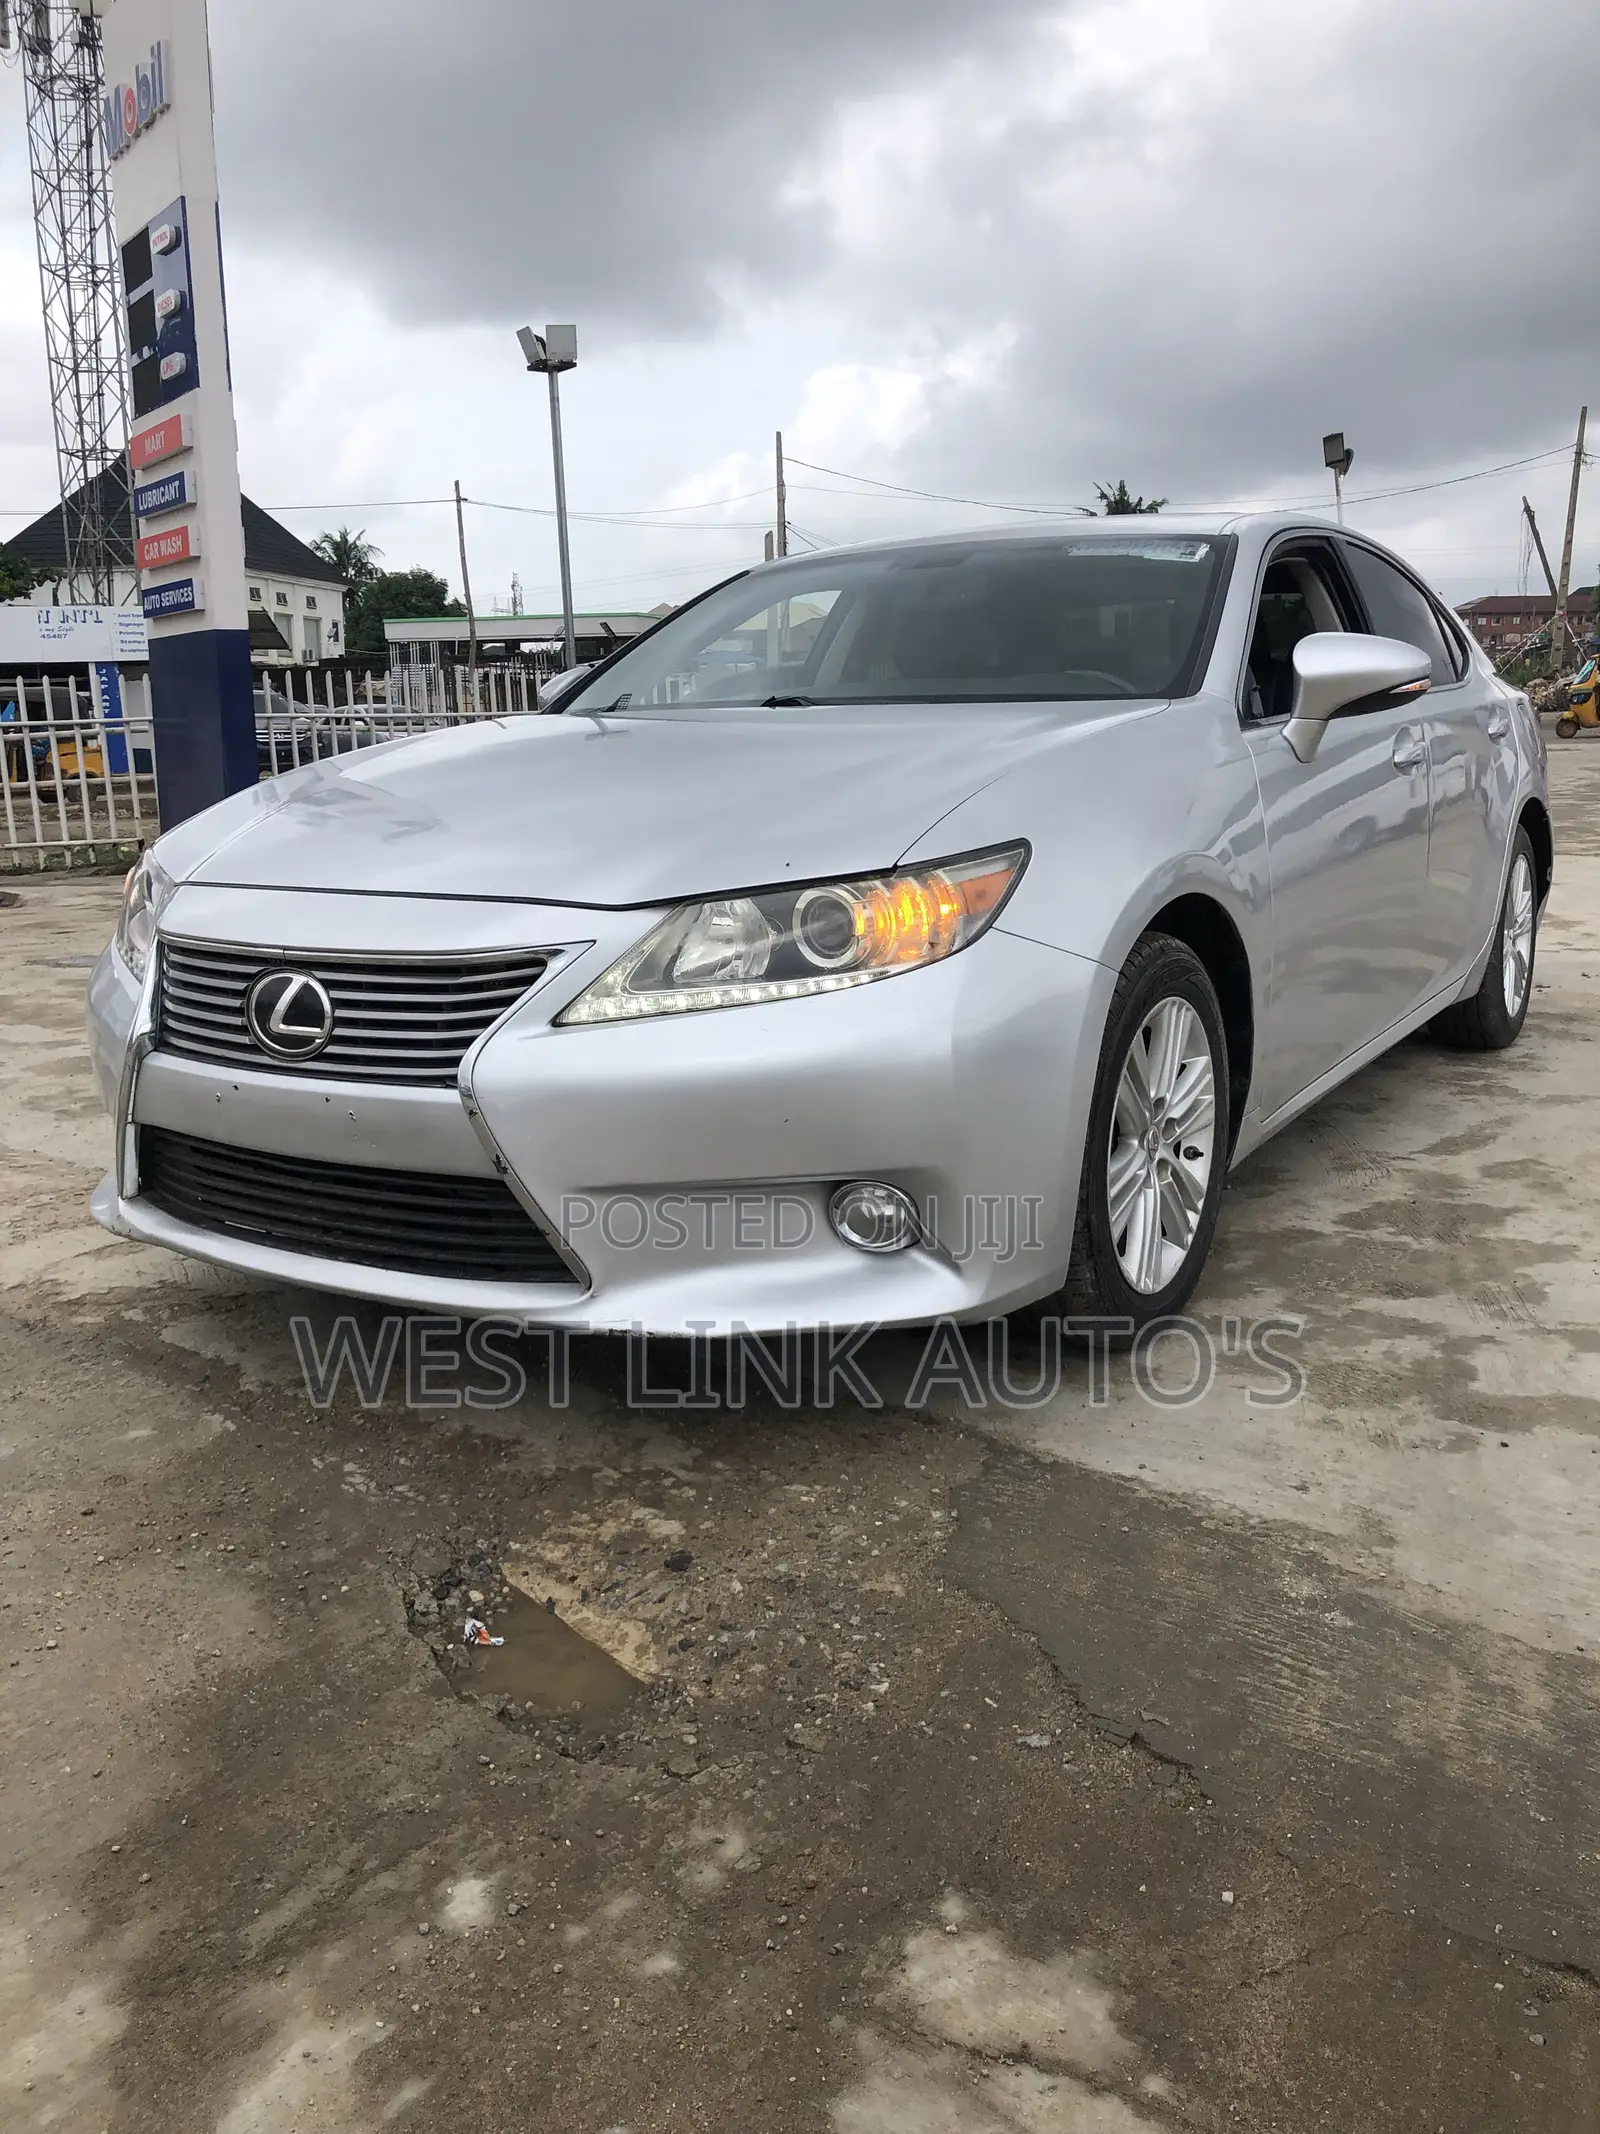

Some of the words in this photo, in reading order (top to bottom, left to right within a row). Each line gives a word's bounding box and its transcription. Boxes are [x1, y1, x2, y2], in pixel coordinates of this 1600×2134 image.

[104, 39, 165, 158] Mobil
[152, 229, 169, 248] PETROL
[161, 358, 174, 376] LPG
[144, 431, 165, 456] MART
[138, 480, 180, 511] LUBRICANT
[144, 540, 160, 561] CAR
[160, 535, 183, 558] WASH
[143, 591, 161, 611] AUTO
[161, 584, 193, 607] SERVICES
